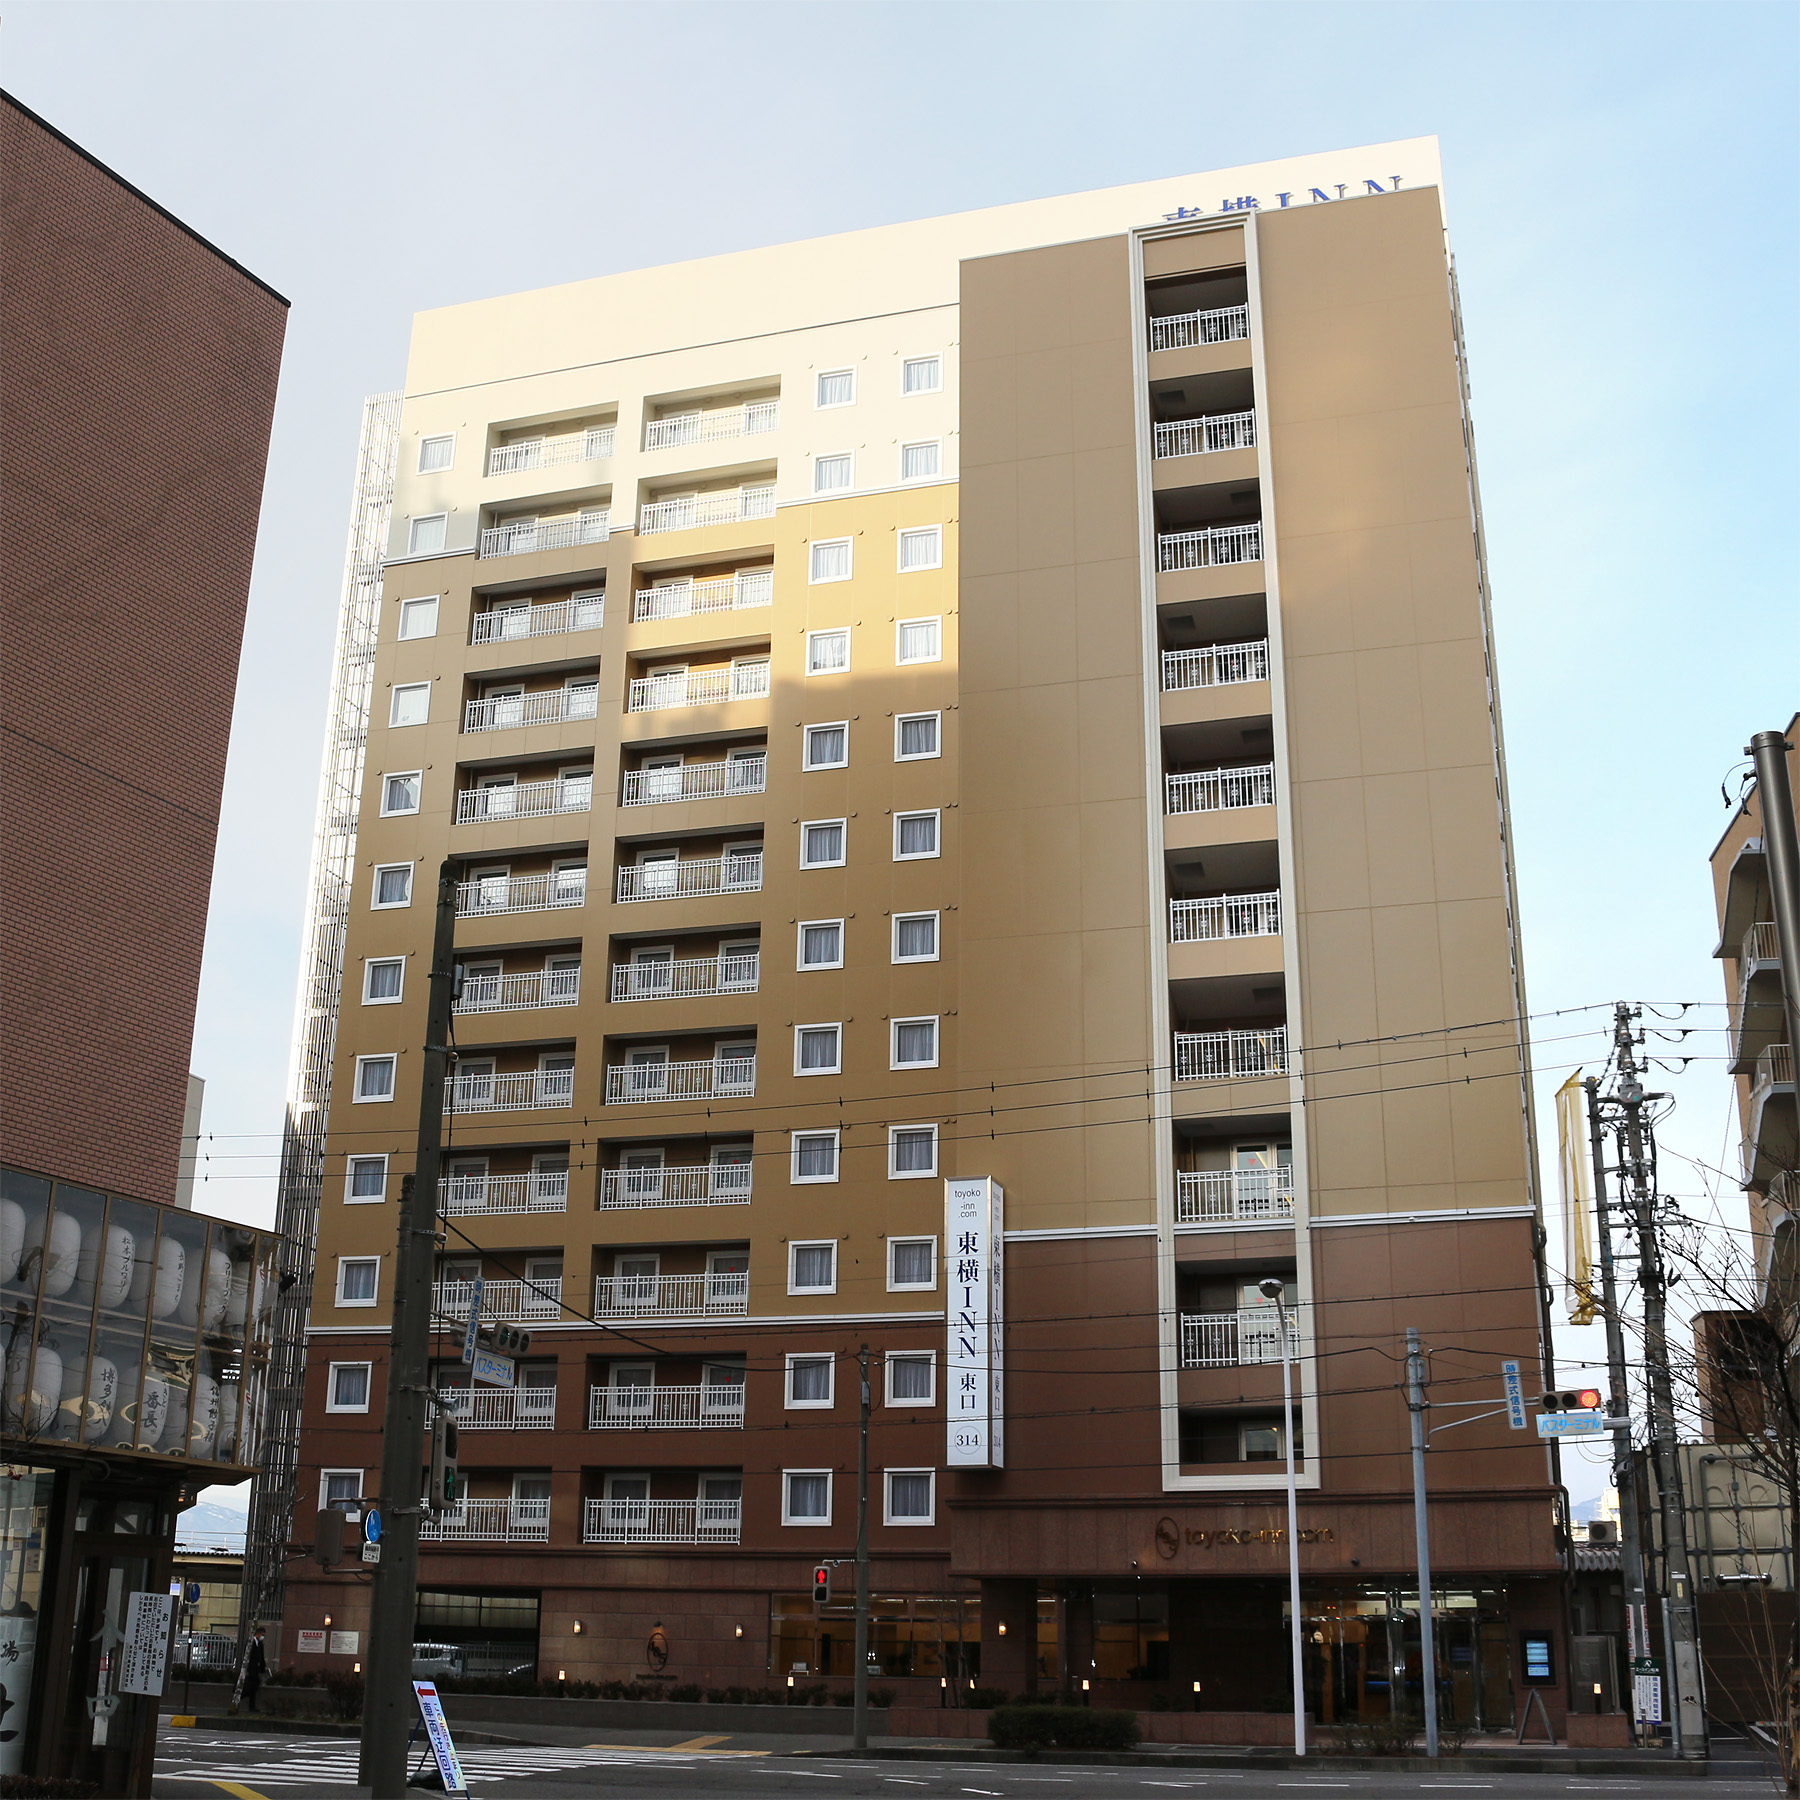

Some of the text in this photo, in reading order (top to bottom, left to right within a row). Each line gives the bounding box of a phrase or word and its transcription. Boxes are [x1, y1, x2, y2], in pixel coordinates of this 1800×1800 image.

[954, 1188, 981, 1200] toyoko
[960, 1202, 975, 1210] -inn
[958, 1210, 977, 1218] .com
[956, 1231, 979, 1410] 東横INN 東口
[1505, 1364, 1523, 1427] 時差式信号機
[1540, 1418, 1600, 1432] バスターミナル
[956, 1434, 979, 1447] 314
[156, 1612, 169, 1678] お知らせ
